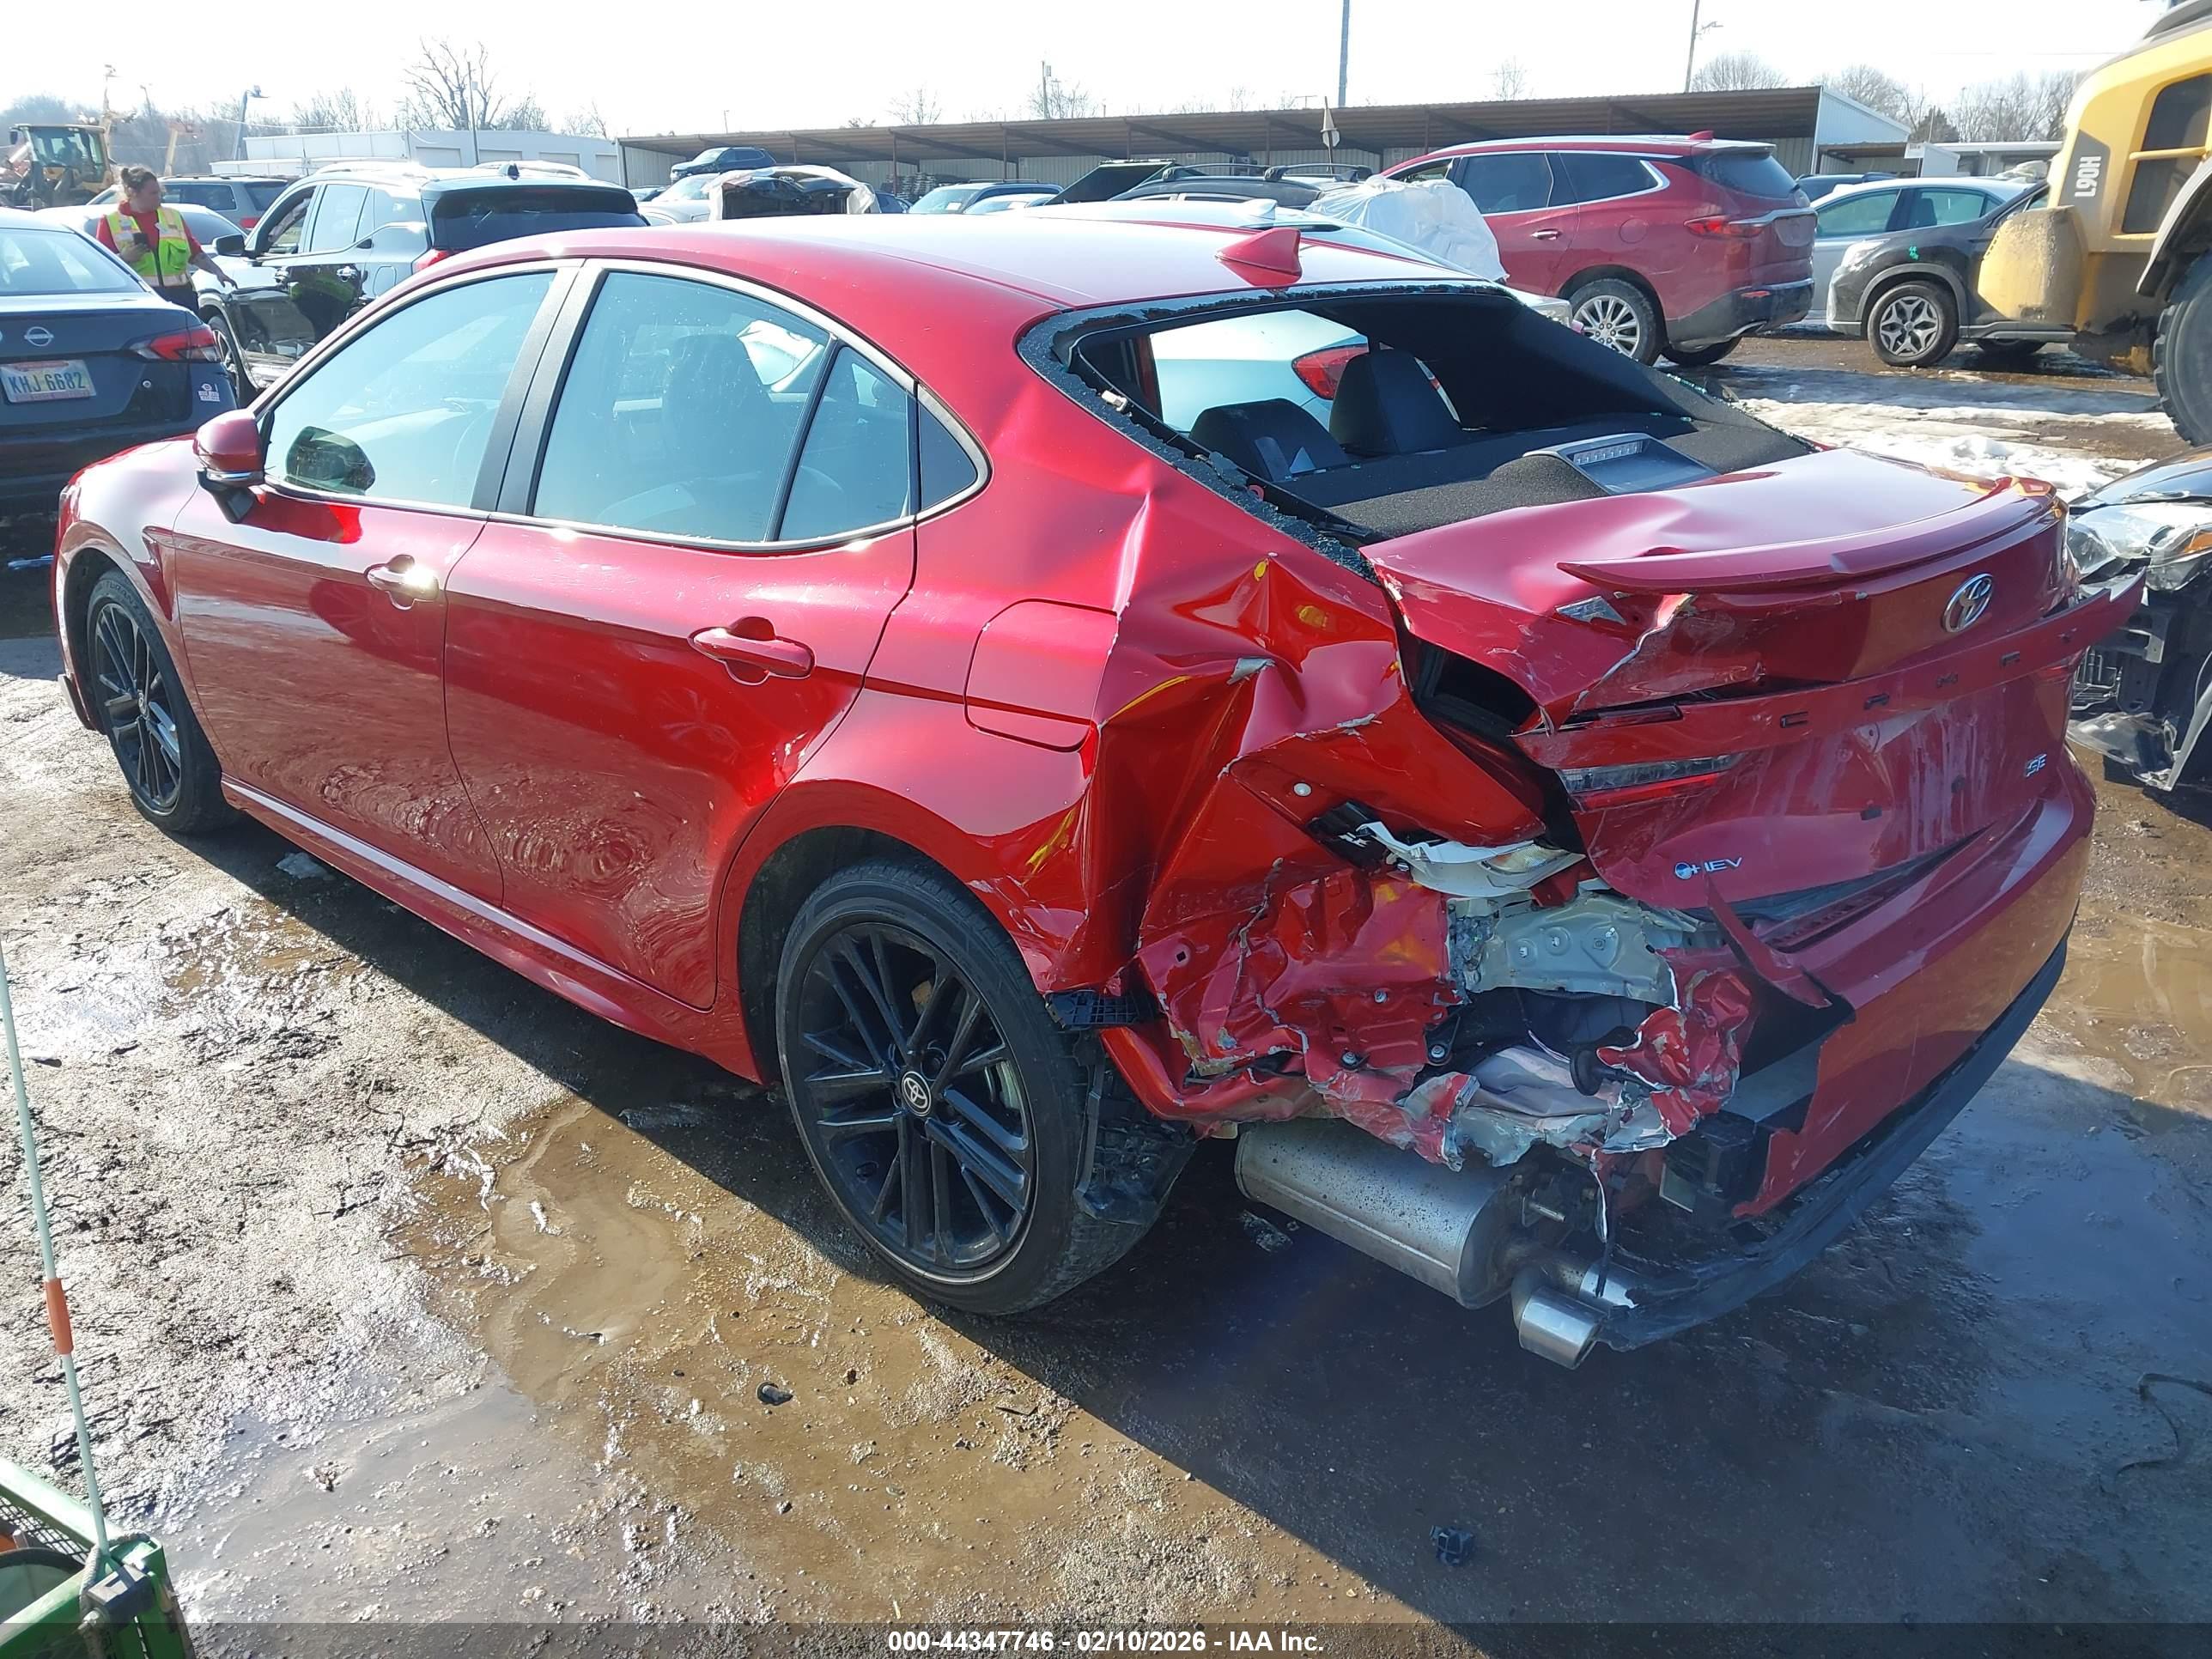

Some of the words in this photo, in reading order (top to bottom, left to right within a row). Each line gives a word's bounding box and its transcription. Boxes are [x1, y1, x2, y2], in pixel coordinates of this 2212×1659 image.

[2074, 155, 2102, 198] L90H
[8, 374, 42, 393] KHJ
[44, 371, 86, 391] 6682
